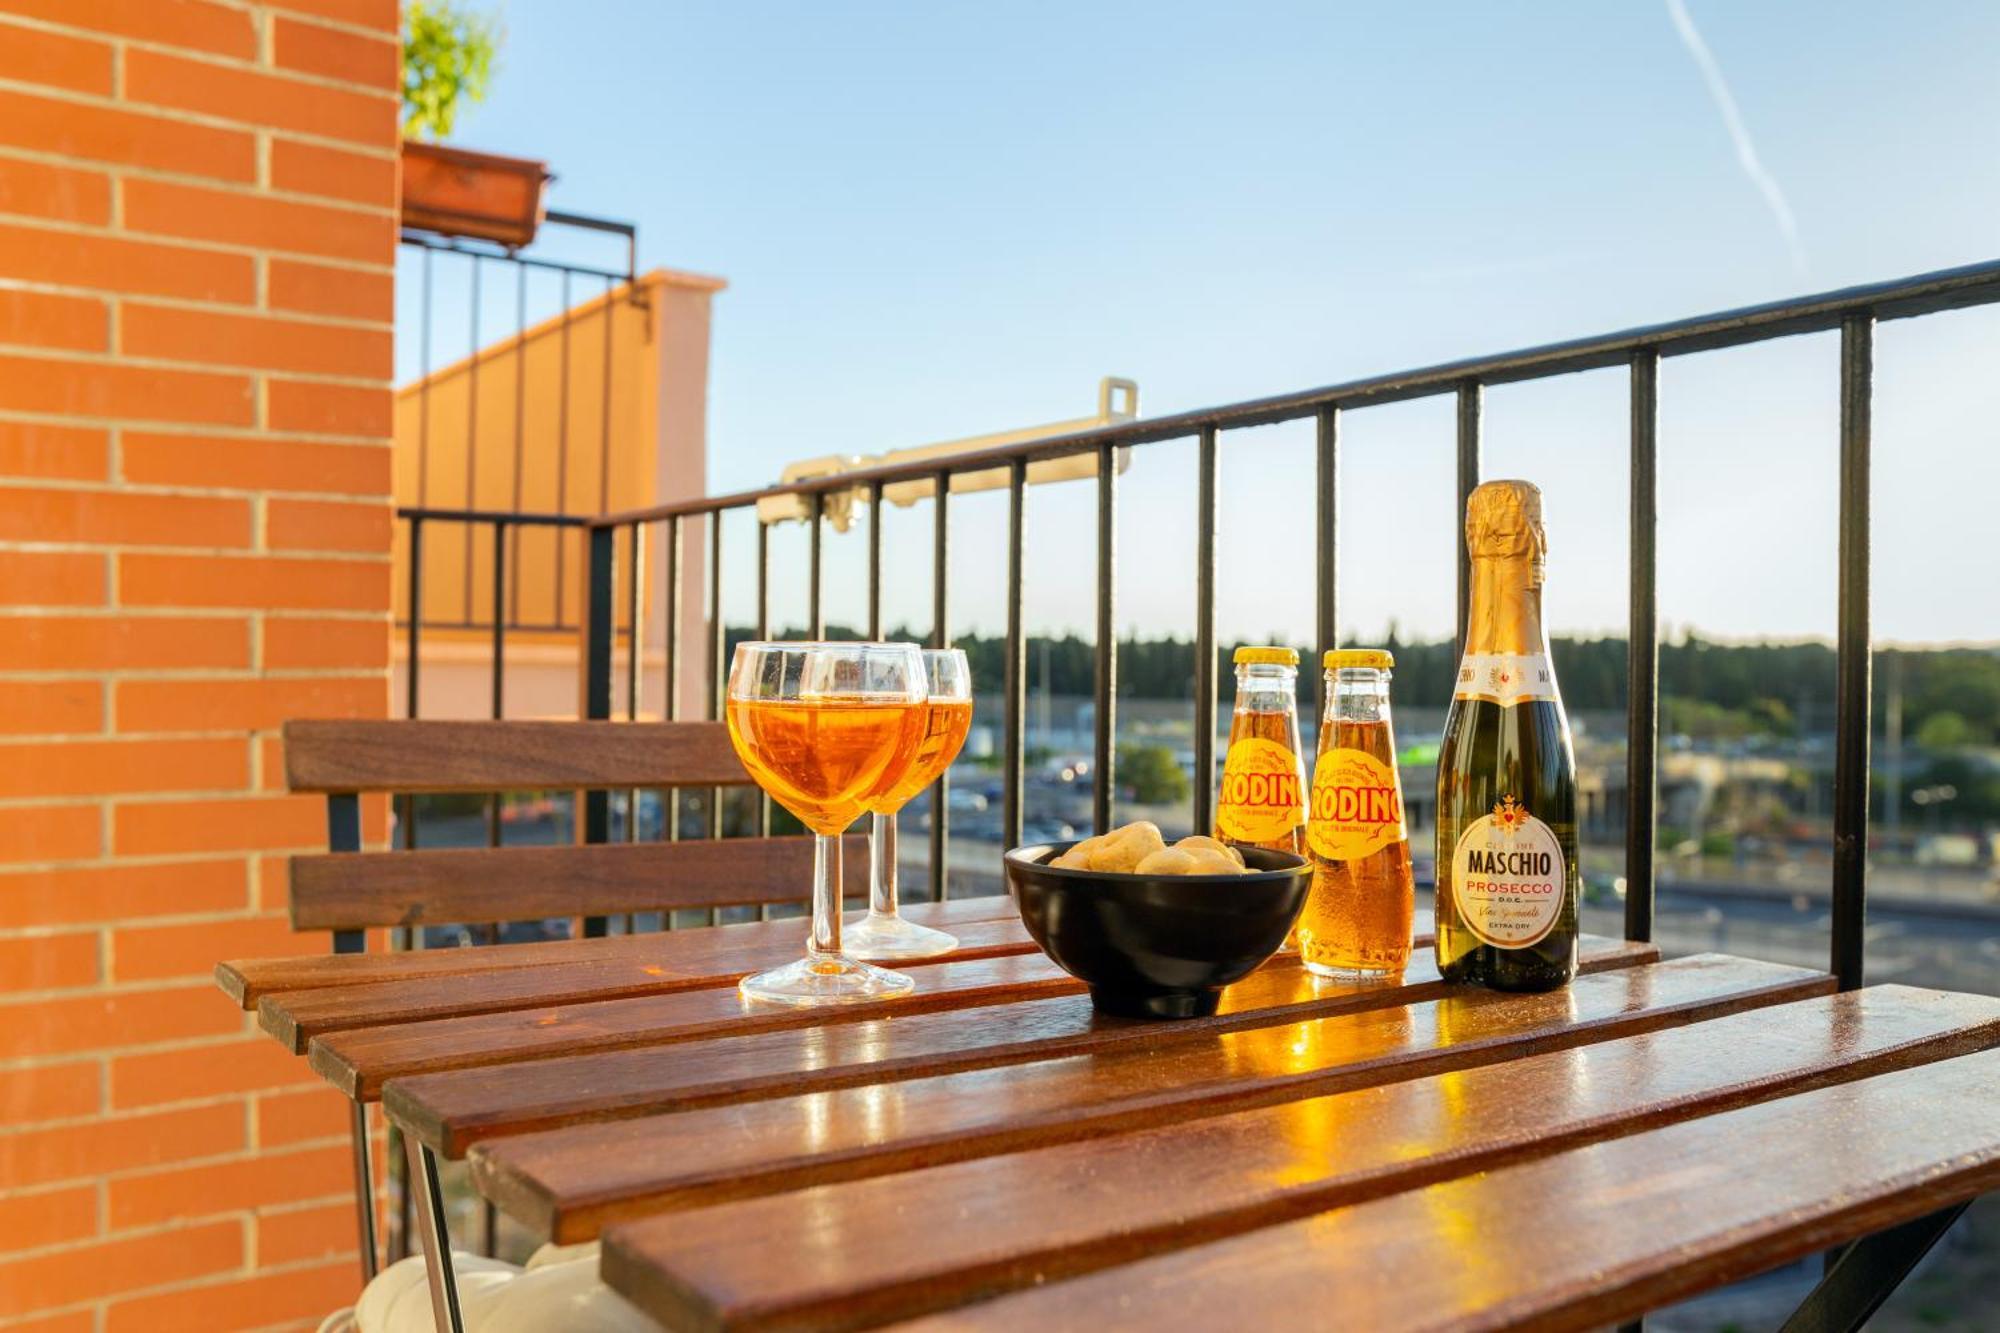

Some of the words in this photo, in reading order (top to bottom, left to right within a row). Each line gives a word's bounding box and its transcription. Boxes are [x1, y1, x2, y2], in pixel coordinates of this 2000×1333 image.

[1220, 773, 1303, 807] RODIN
[1311, 786, 1400, 824] RODIN
[1468, 850, 1551, 876] MASCHIO
[1467, 881, 1553, 894] PROSECCO
